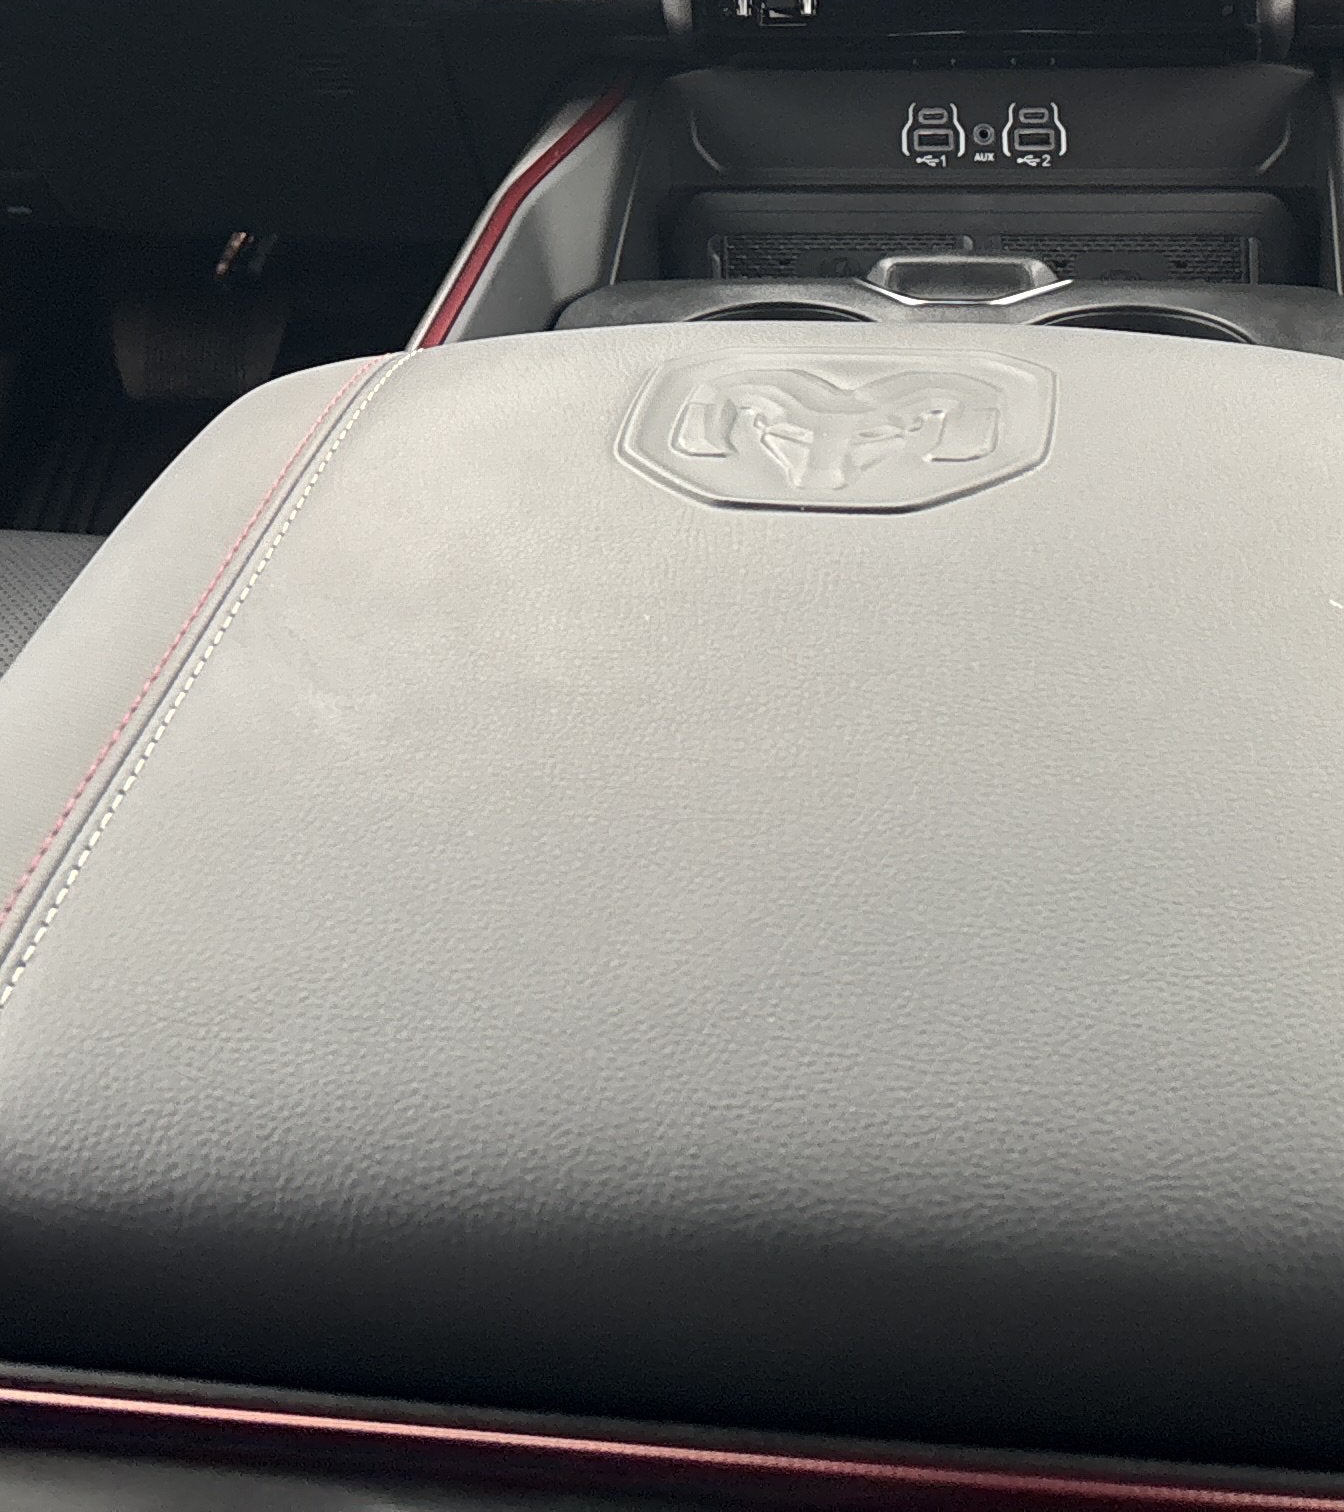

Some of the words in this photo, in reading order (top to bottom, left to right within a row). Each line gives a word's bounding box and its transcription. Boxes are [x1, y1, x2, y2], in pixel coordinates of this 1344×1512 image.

[940, 155, 947, 167] 1
[973, 152, 995, 162] AUX
[1042, 154, 1052, 167] 2
